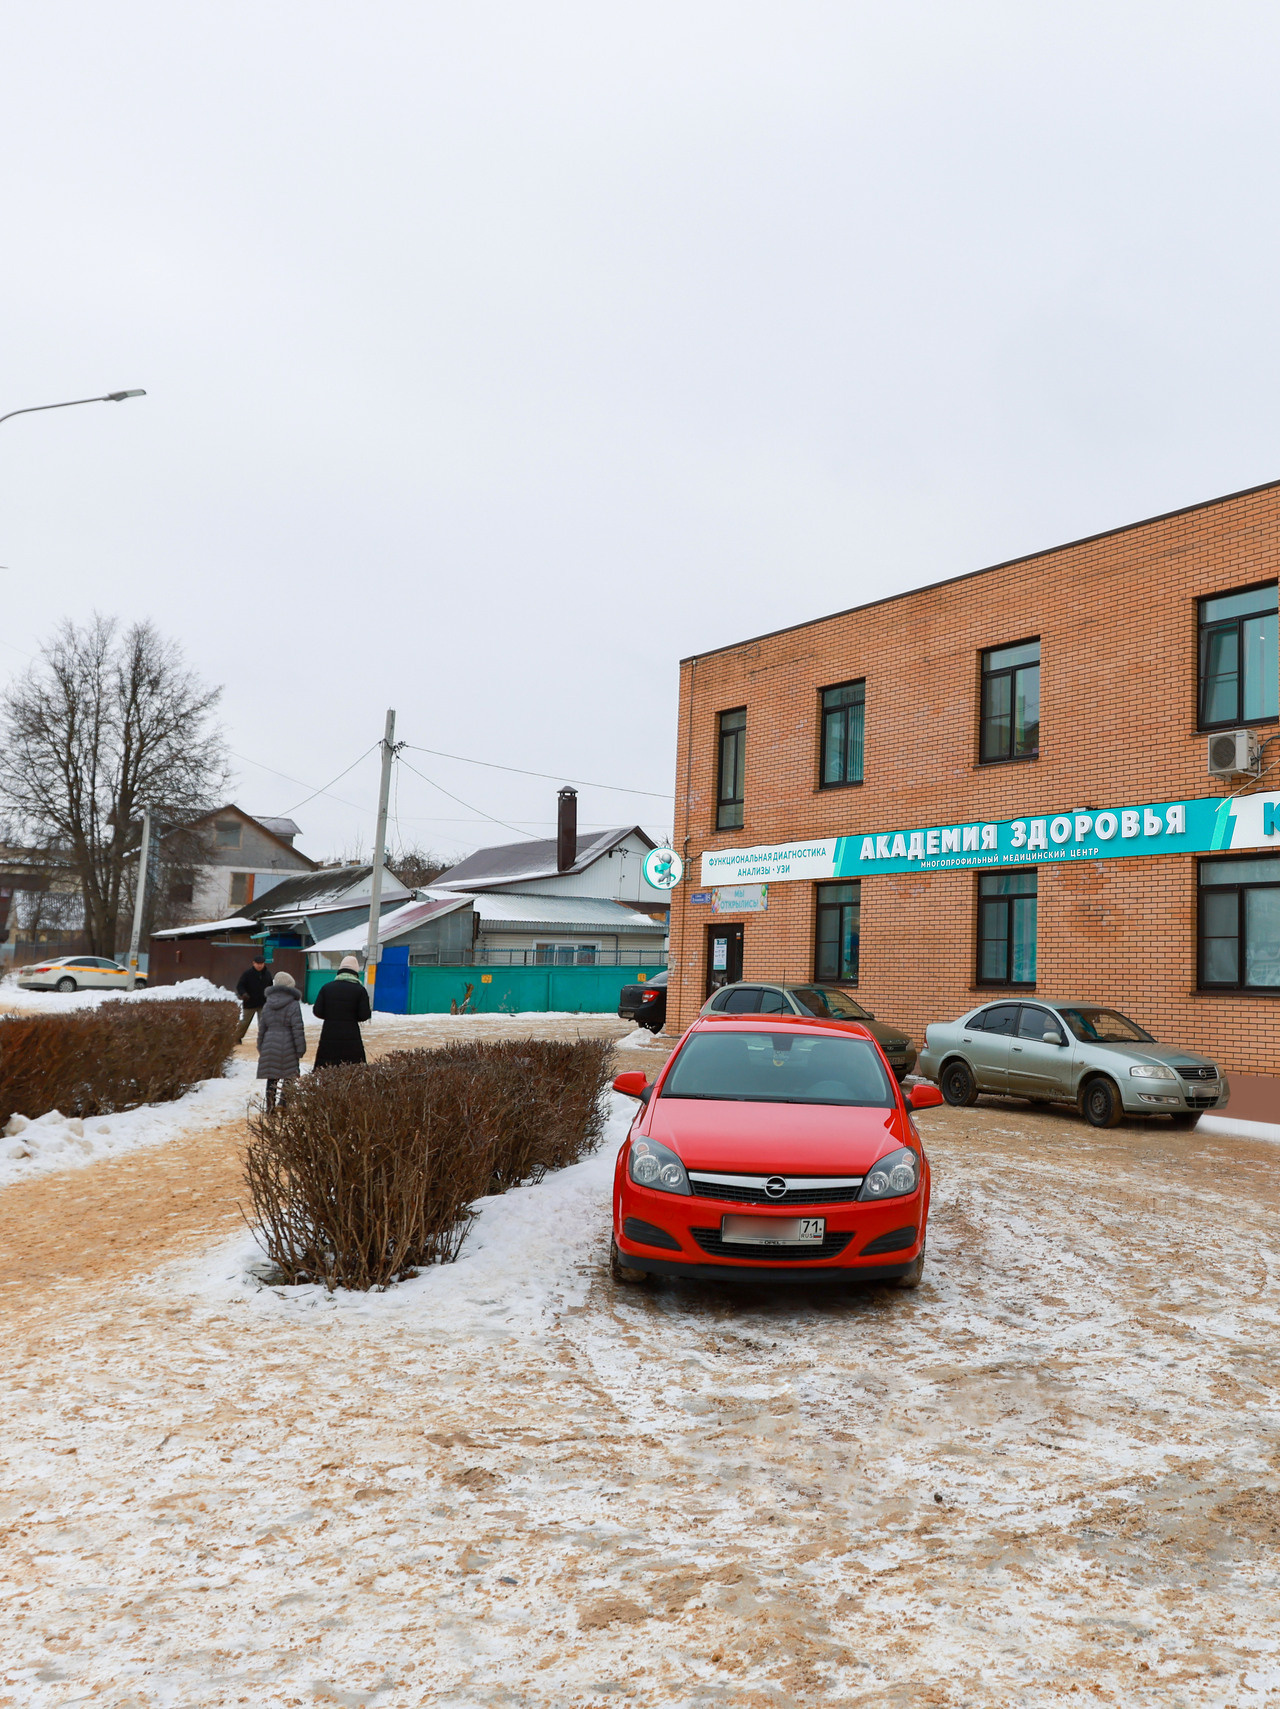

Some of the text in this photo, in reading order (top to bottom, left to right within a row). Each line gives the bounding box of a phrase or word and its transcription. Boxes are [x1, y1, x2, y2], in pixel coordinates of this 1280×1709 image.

[859, 805, 1186, 861] АКАДЕМИЯ ЗДОРОВЬЯ
[708, 847, 827, 867] ФУНКЦИОНАЛЬНАЯ ДИАГНОСТИКА
[920, 848, 1099, 868] МНОГОПРОФИЛЬНЫЙ МЕДИЦИНСКИЙ ЦЕНТР
[737, 865, 790, 877] АНАЛИЗЫ УЗИ
[802, 1220, 818, 1233] 71
